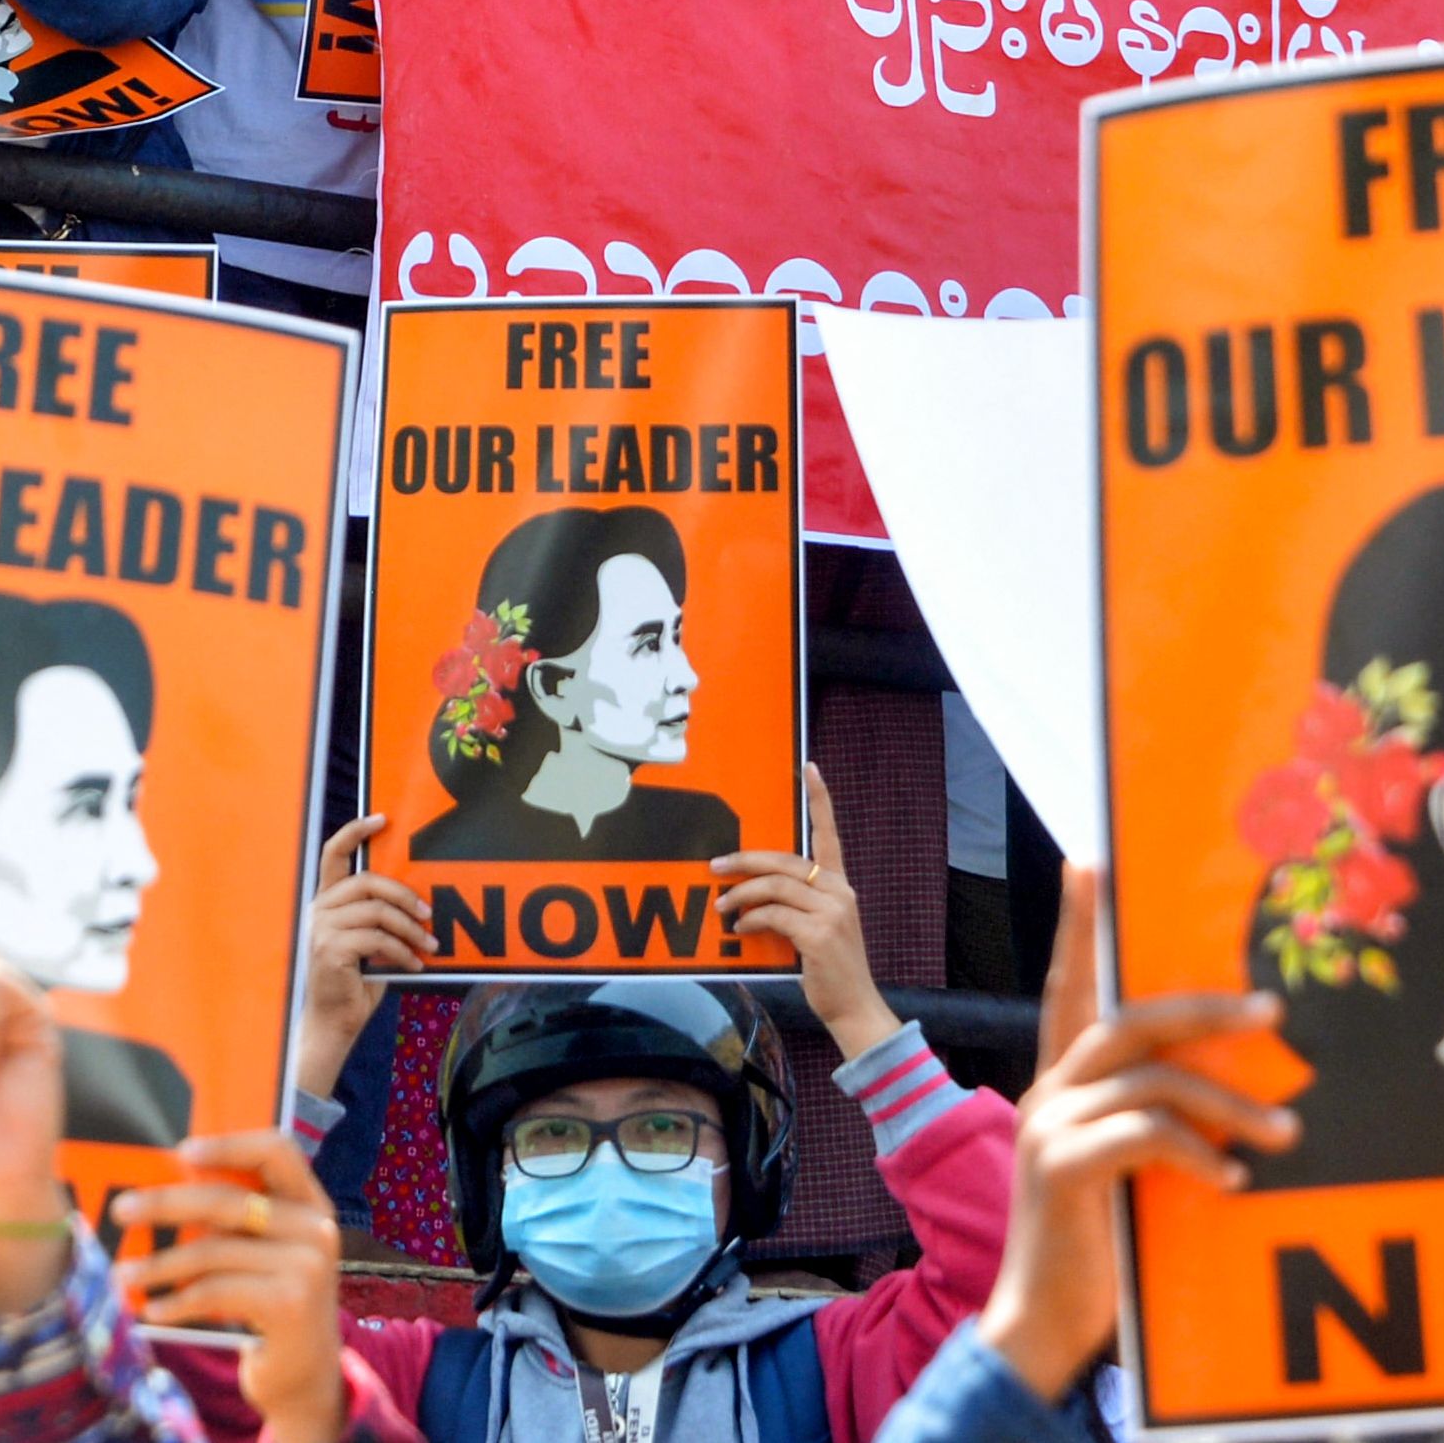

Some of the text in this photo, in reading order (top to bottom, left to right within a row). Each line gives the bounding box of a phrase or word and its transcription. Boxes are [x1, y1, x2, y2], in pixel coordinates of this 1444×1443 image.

[505, 321, 651, 389] FREE
[1122, 316, 1373, 470] OUR
[391, 423, 779, 494] OUR LEADER
[430, 884, 742, 959] NOW!
